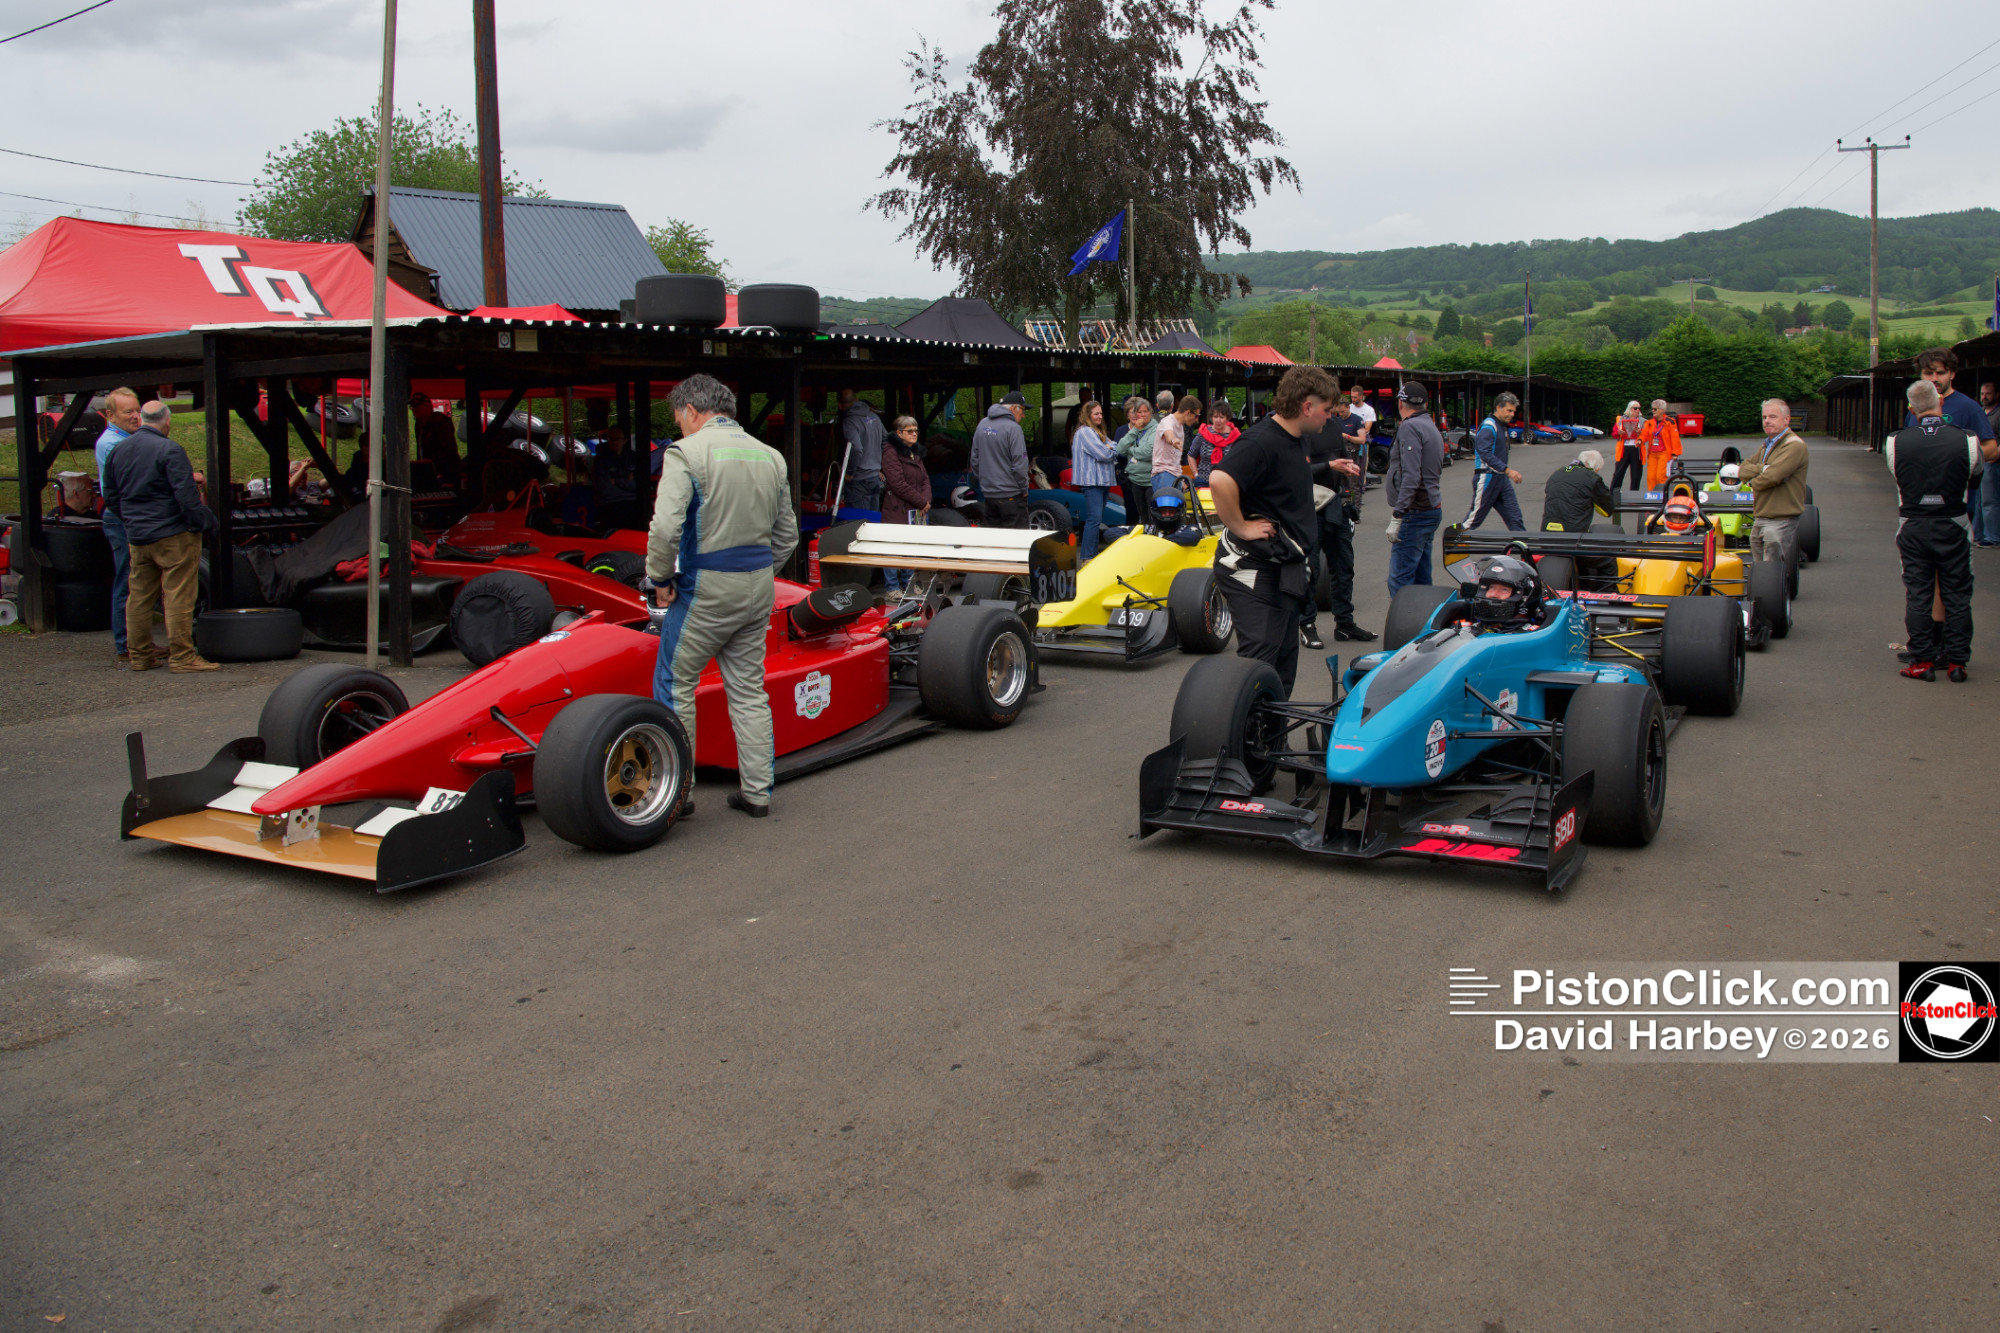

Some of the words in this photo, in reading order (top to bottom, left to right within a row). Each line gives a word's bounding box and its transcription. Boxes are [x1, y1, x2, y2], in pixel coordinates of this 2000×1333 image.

[178, 243, 333, 321] TQ
[1577, 590, 1639, 602] Racing
[1117, 610, 1144, 626] 809
[1554, 812, 1575, 847] SBD
